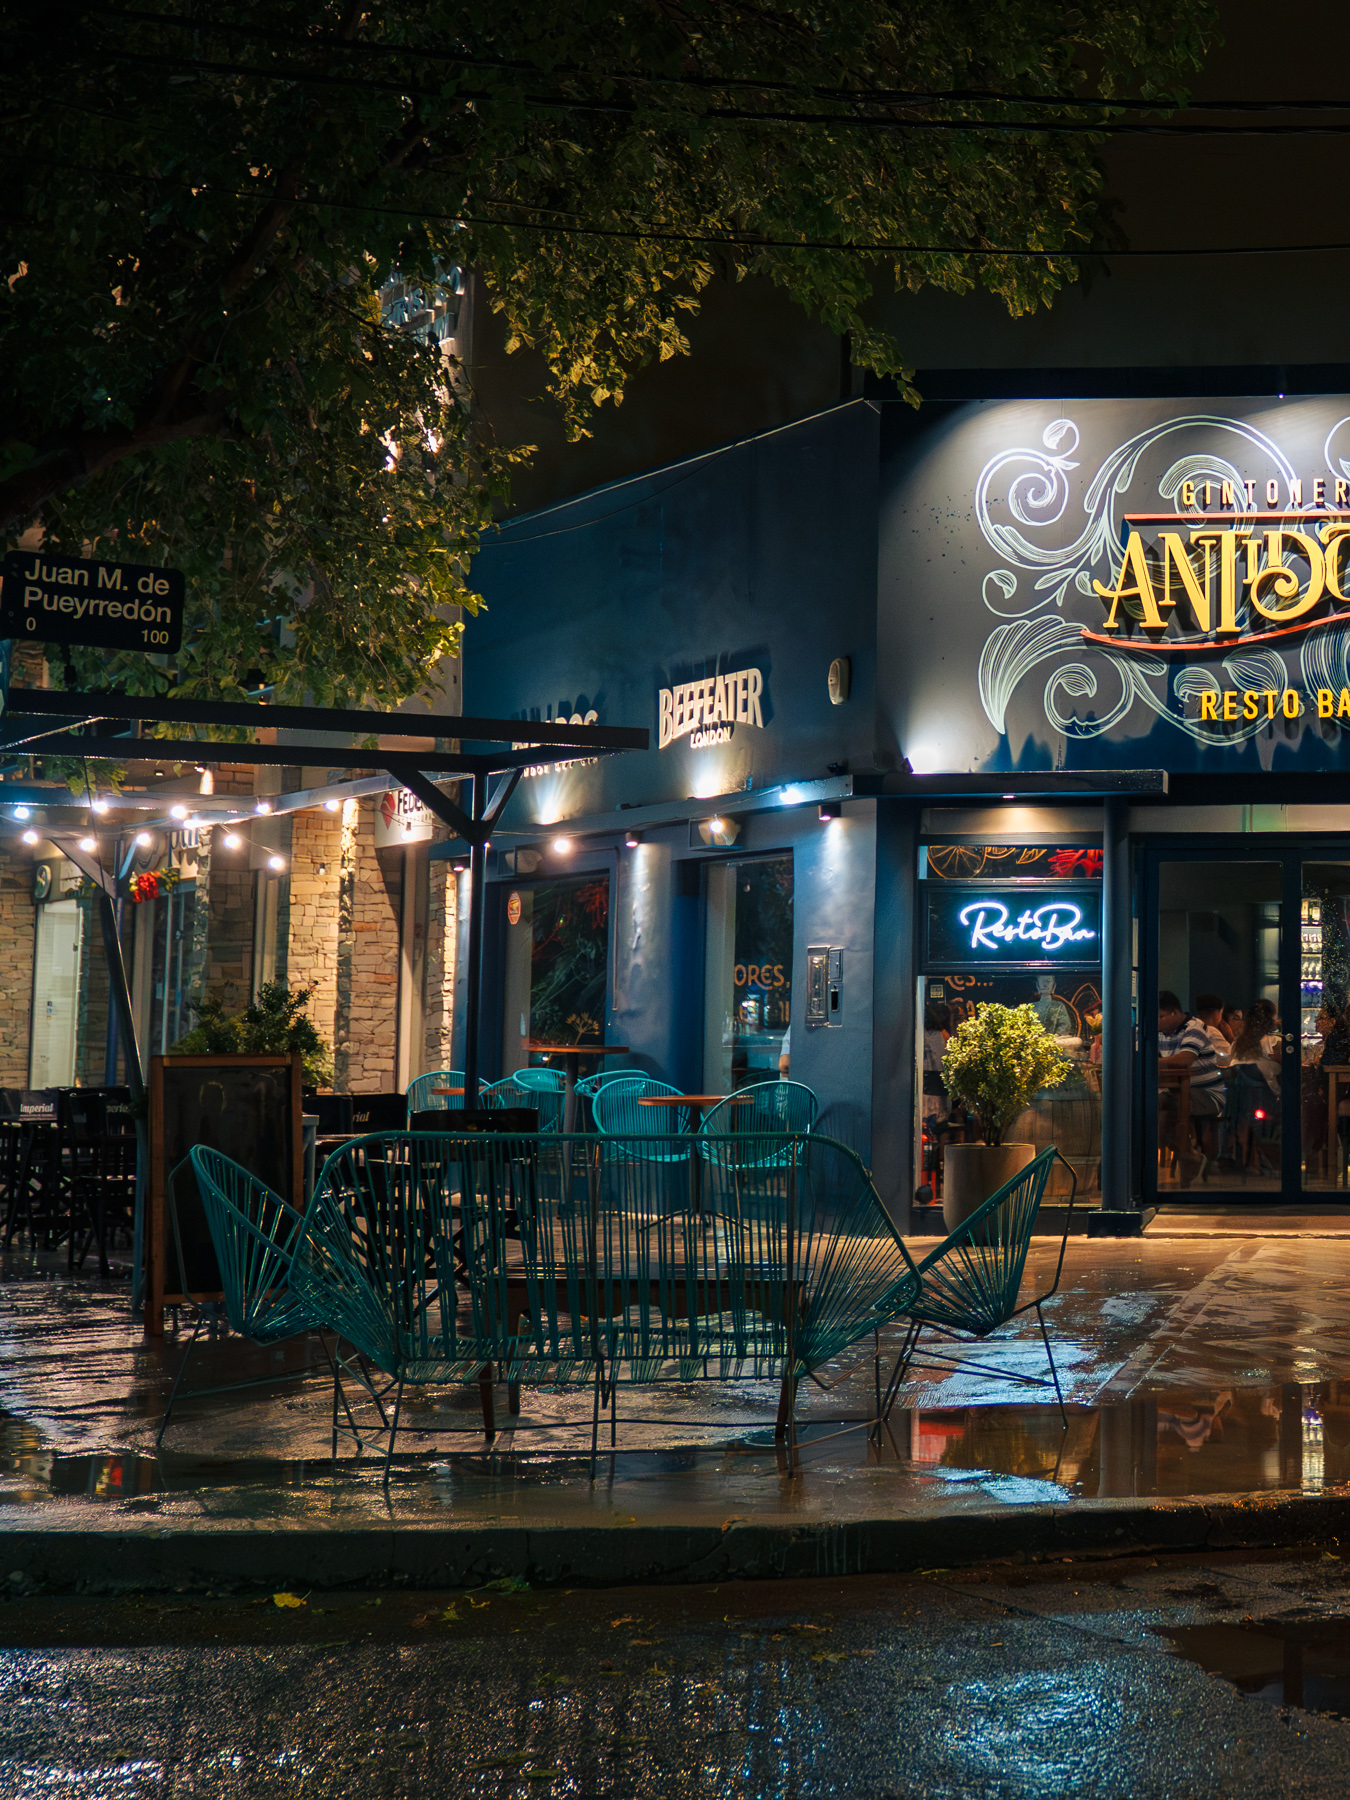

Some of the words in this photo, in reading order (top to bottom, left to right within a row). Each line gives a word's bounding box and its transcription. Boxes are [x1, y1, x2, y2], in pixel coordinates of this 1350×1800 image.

[24, 559, 89, 587] Juan
[97, 566, 129, 591] M.
[137, 573, 170, 596] de
[23, 586, 172, 624] Pueyrredón
[26, 617, 37, 631] 0
[141, 630, 170, 645] 100
[658, 667, 764, 750] BEEFEATER
[1201, 688, 1299, 721] RESTO
[690, 725, 732, 749] LONDON
[20, 1103, 54, 1115] Imperial
